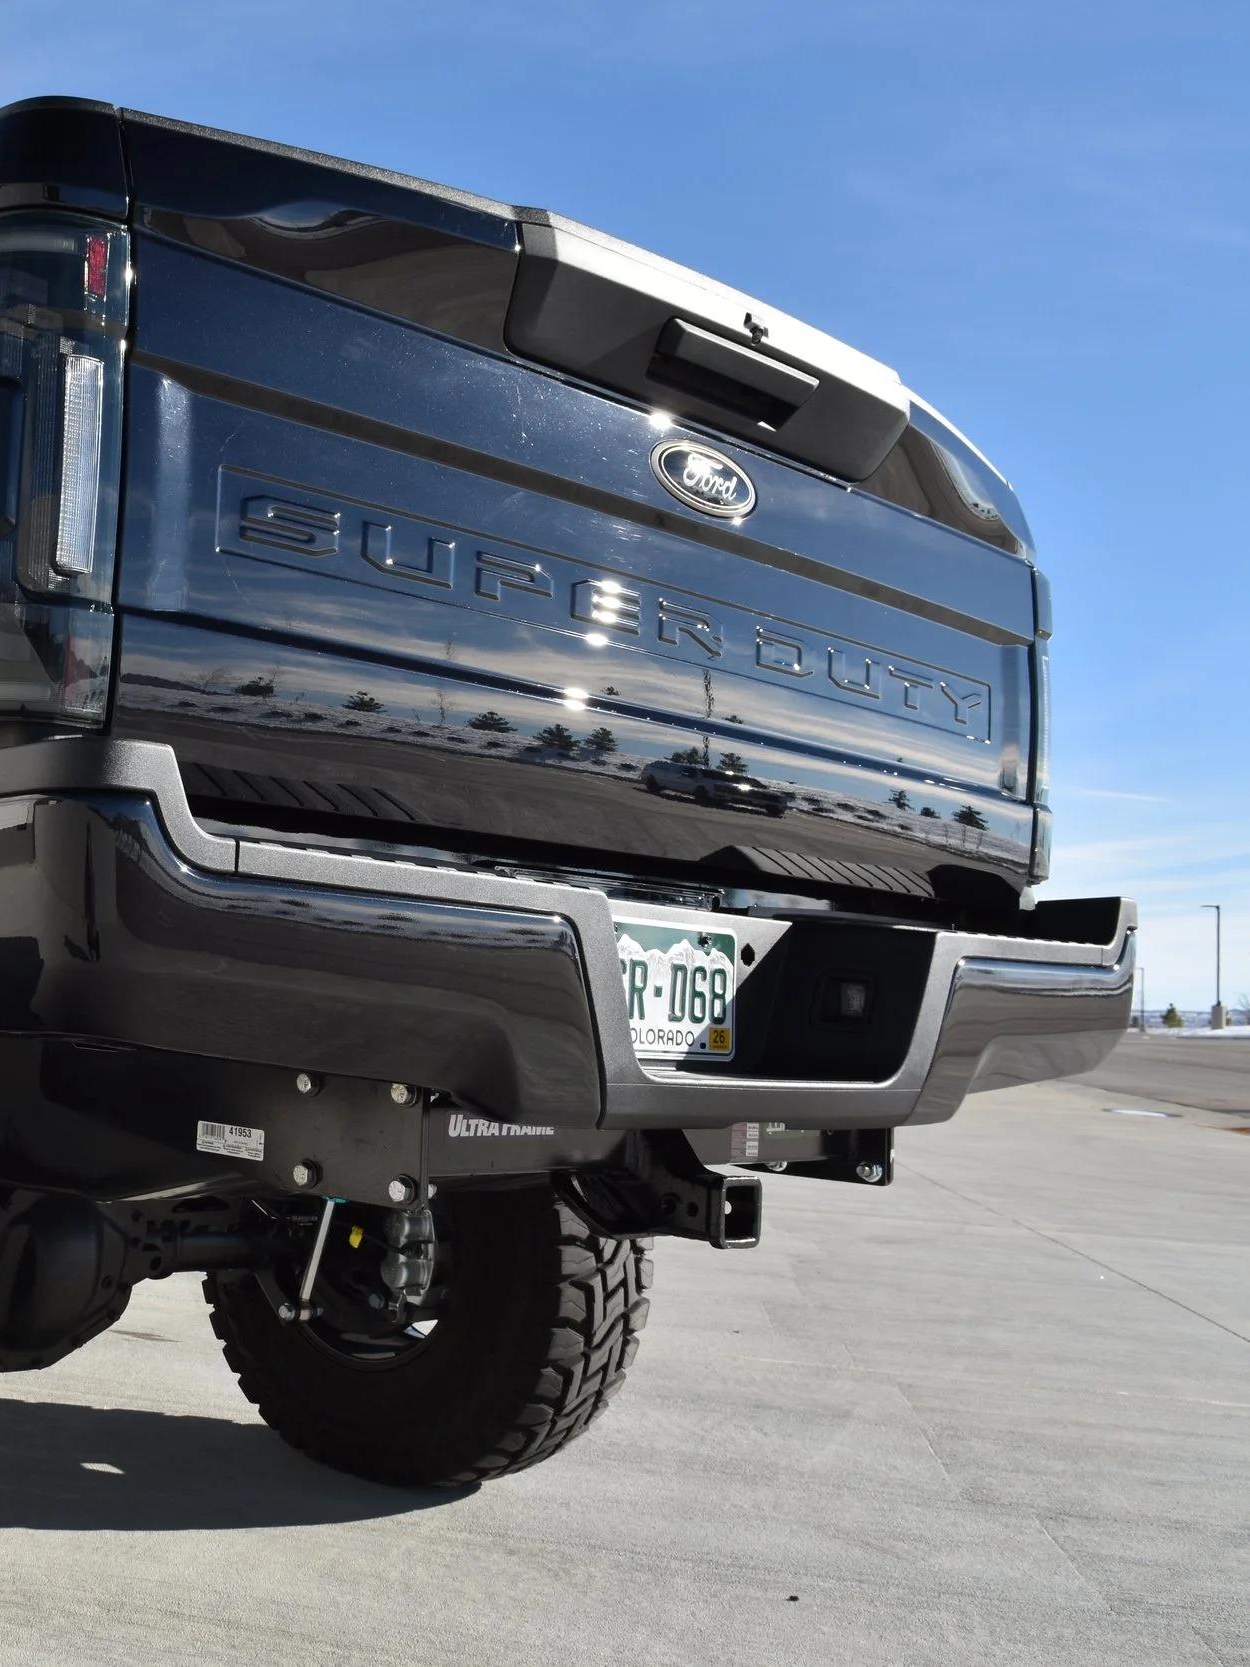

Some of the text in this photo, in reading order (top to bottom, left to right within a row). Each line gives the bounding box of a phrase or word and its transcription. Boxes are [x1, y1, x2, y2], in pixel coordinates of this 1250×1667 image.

[682, 453, 738, 501] Ford
[239, 495, 983, 724] SUPER DUTY
[619, 958, 728, 1025] R-D68
[630, 1027, 695, 1047] OLORADO
[712, 1029, 726, 1043] 26
[228, 1126, 252, 1138] 41953
[447, 1114, 500, 1138] ULTRA
